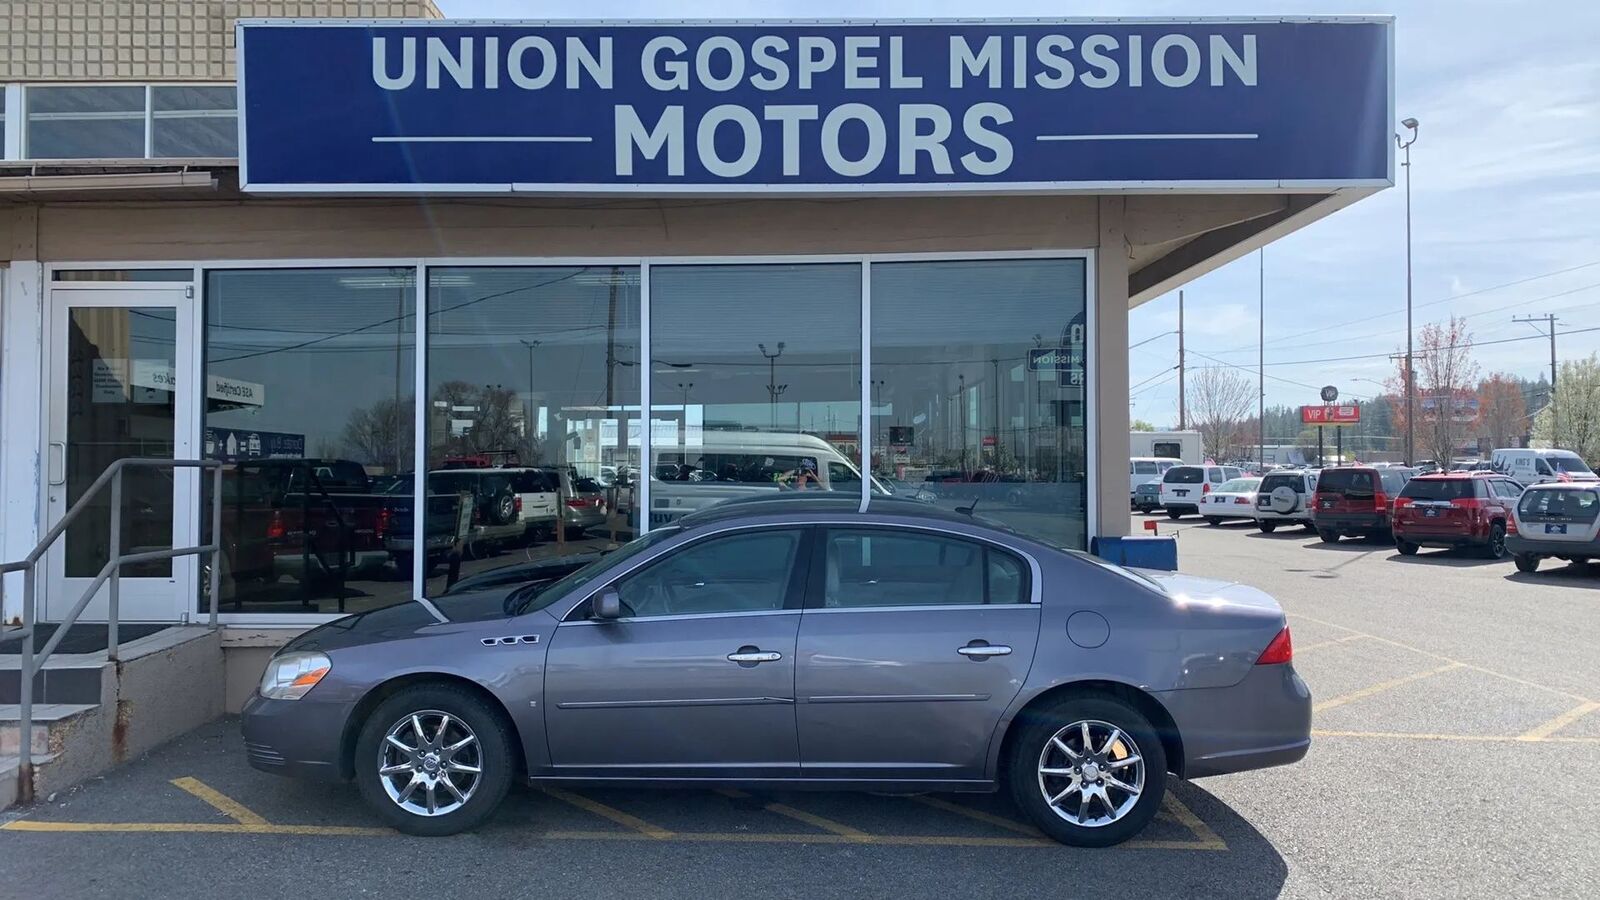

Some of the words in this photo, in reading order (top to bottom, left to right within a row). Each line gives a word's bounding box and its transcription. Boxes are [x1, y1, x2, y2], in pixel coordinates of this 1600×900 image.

[373, 37, 612, 89] UNION
[642, 36, 922, 90] GOSPEL
[950, 35, 1256, 88] MISSION
[616, 103, 1013, 176] MOTORS
